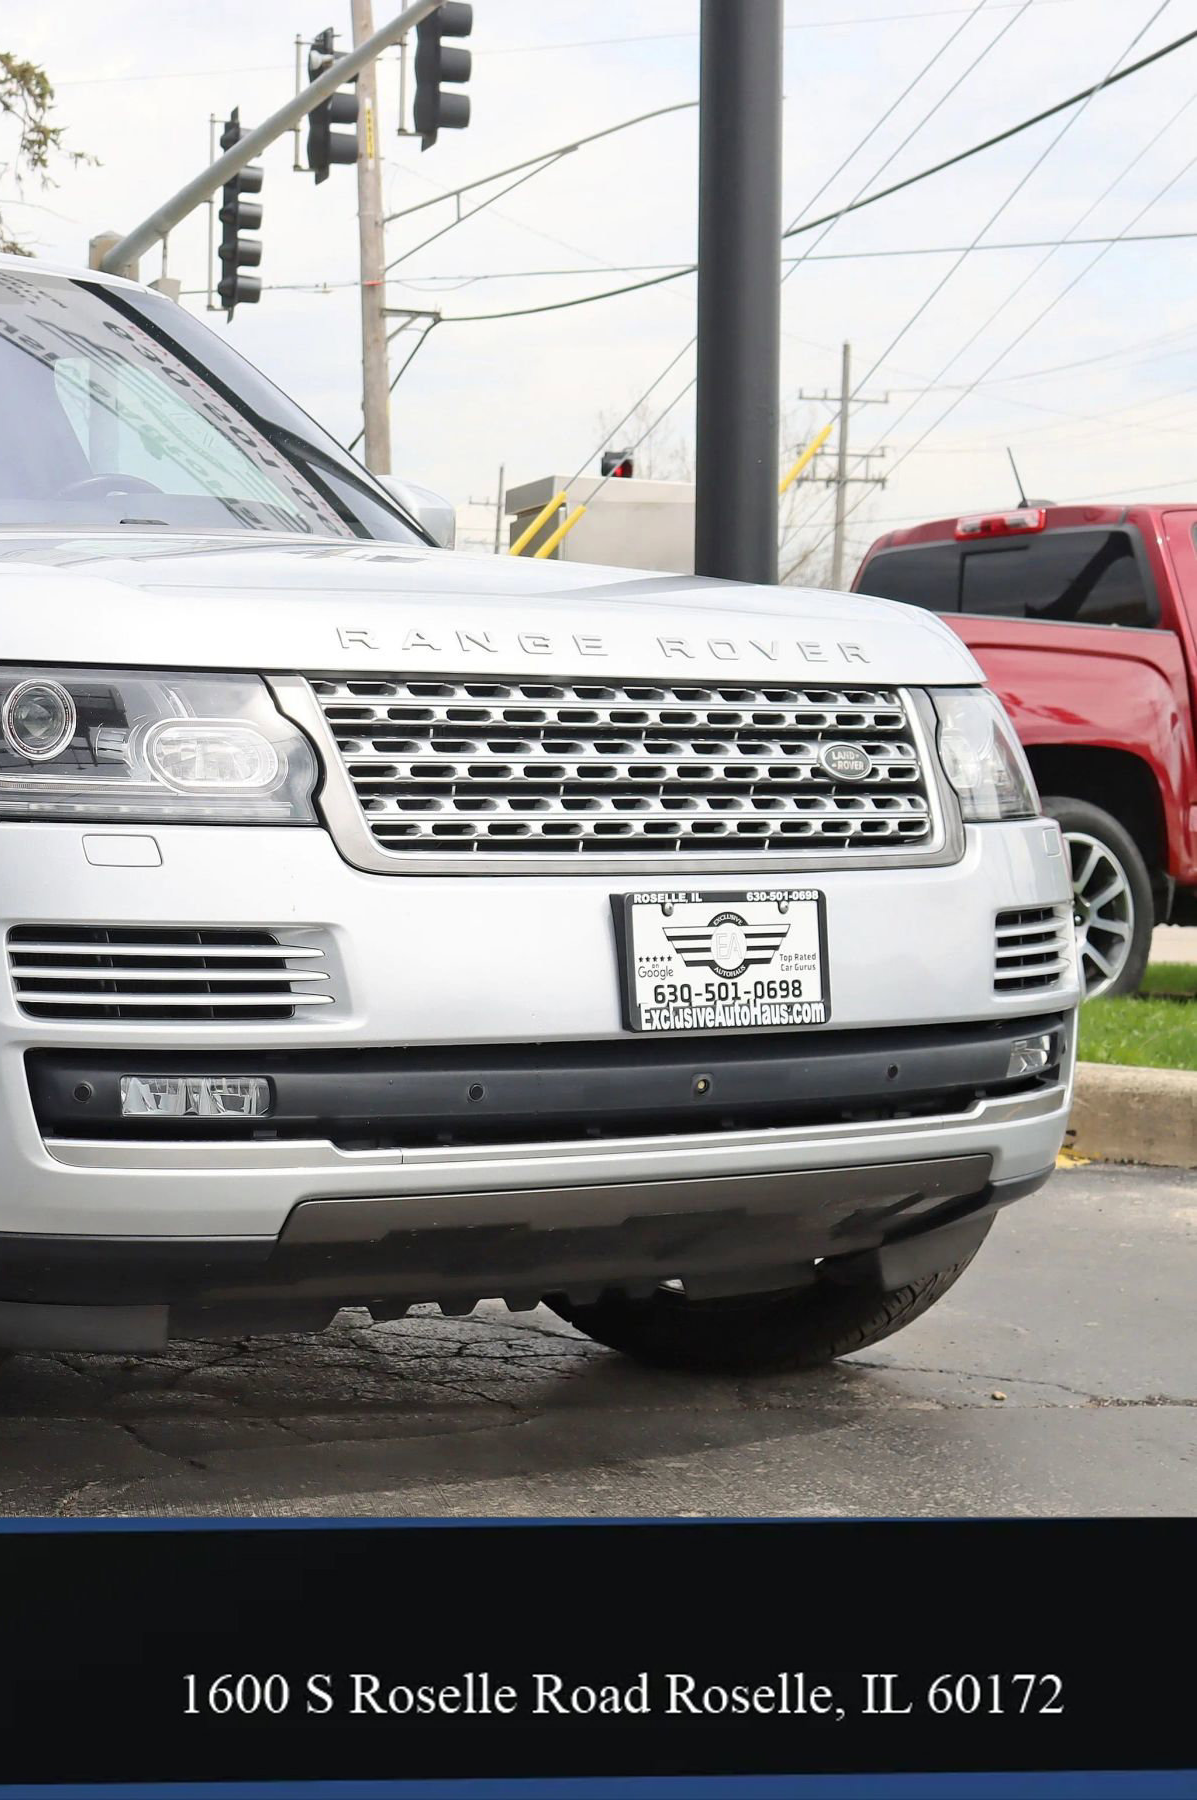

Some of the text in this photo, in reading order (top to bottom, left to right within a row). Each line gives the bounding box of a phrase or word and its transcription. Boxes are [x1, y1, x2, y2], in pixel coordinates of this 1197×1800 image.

[336, 627, 871, 664] RANGE ROVER
[832, 751, 855, 760] LAND
[837, 760, 865, 770] ROVER
[634, 892, 703, 904] ROSELLE, IL
[746, 890, 819, 902] 630-501-0698
[713, 913, 744, 926] EXCLUSIVE
[715, 932, 744, 960] EA
[779, 952, 817, 963] Top Rated
[638, 965, 674, 981] Google
[714, 965, 746, 978] AUTOHAUS
[780, 963, 816, 972] Car Gurus
[654, 979, 803, 1004] 630-501-0698
[641, 1001, 825, 1031] ExclusiveAutoHaus.com
